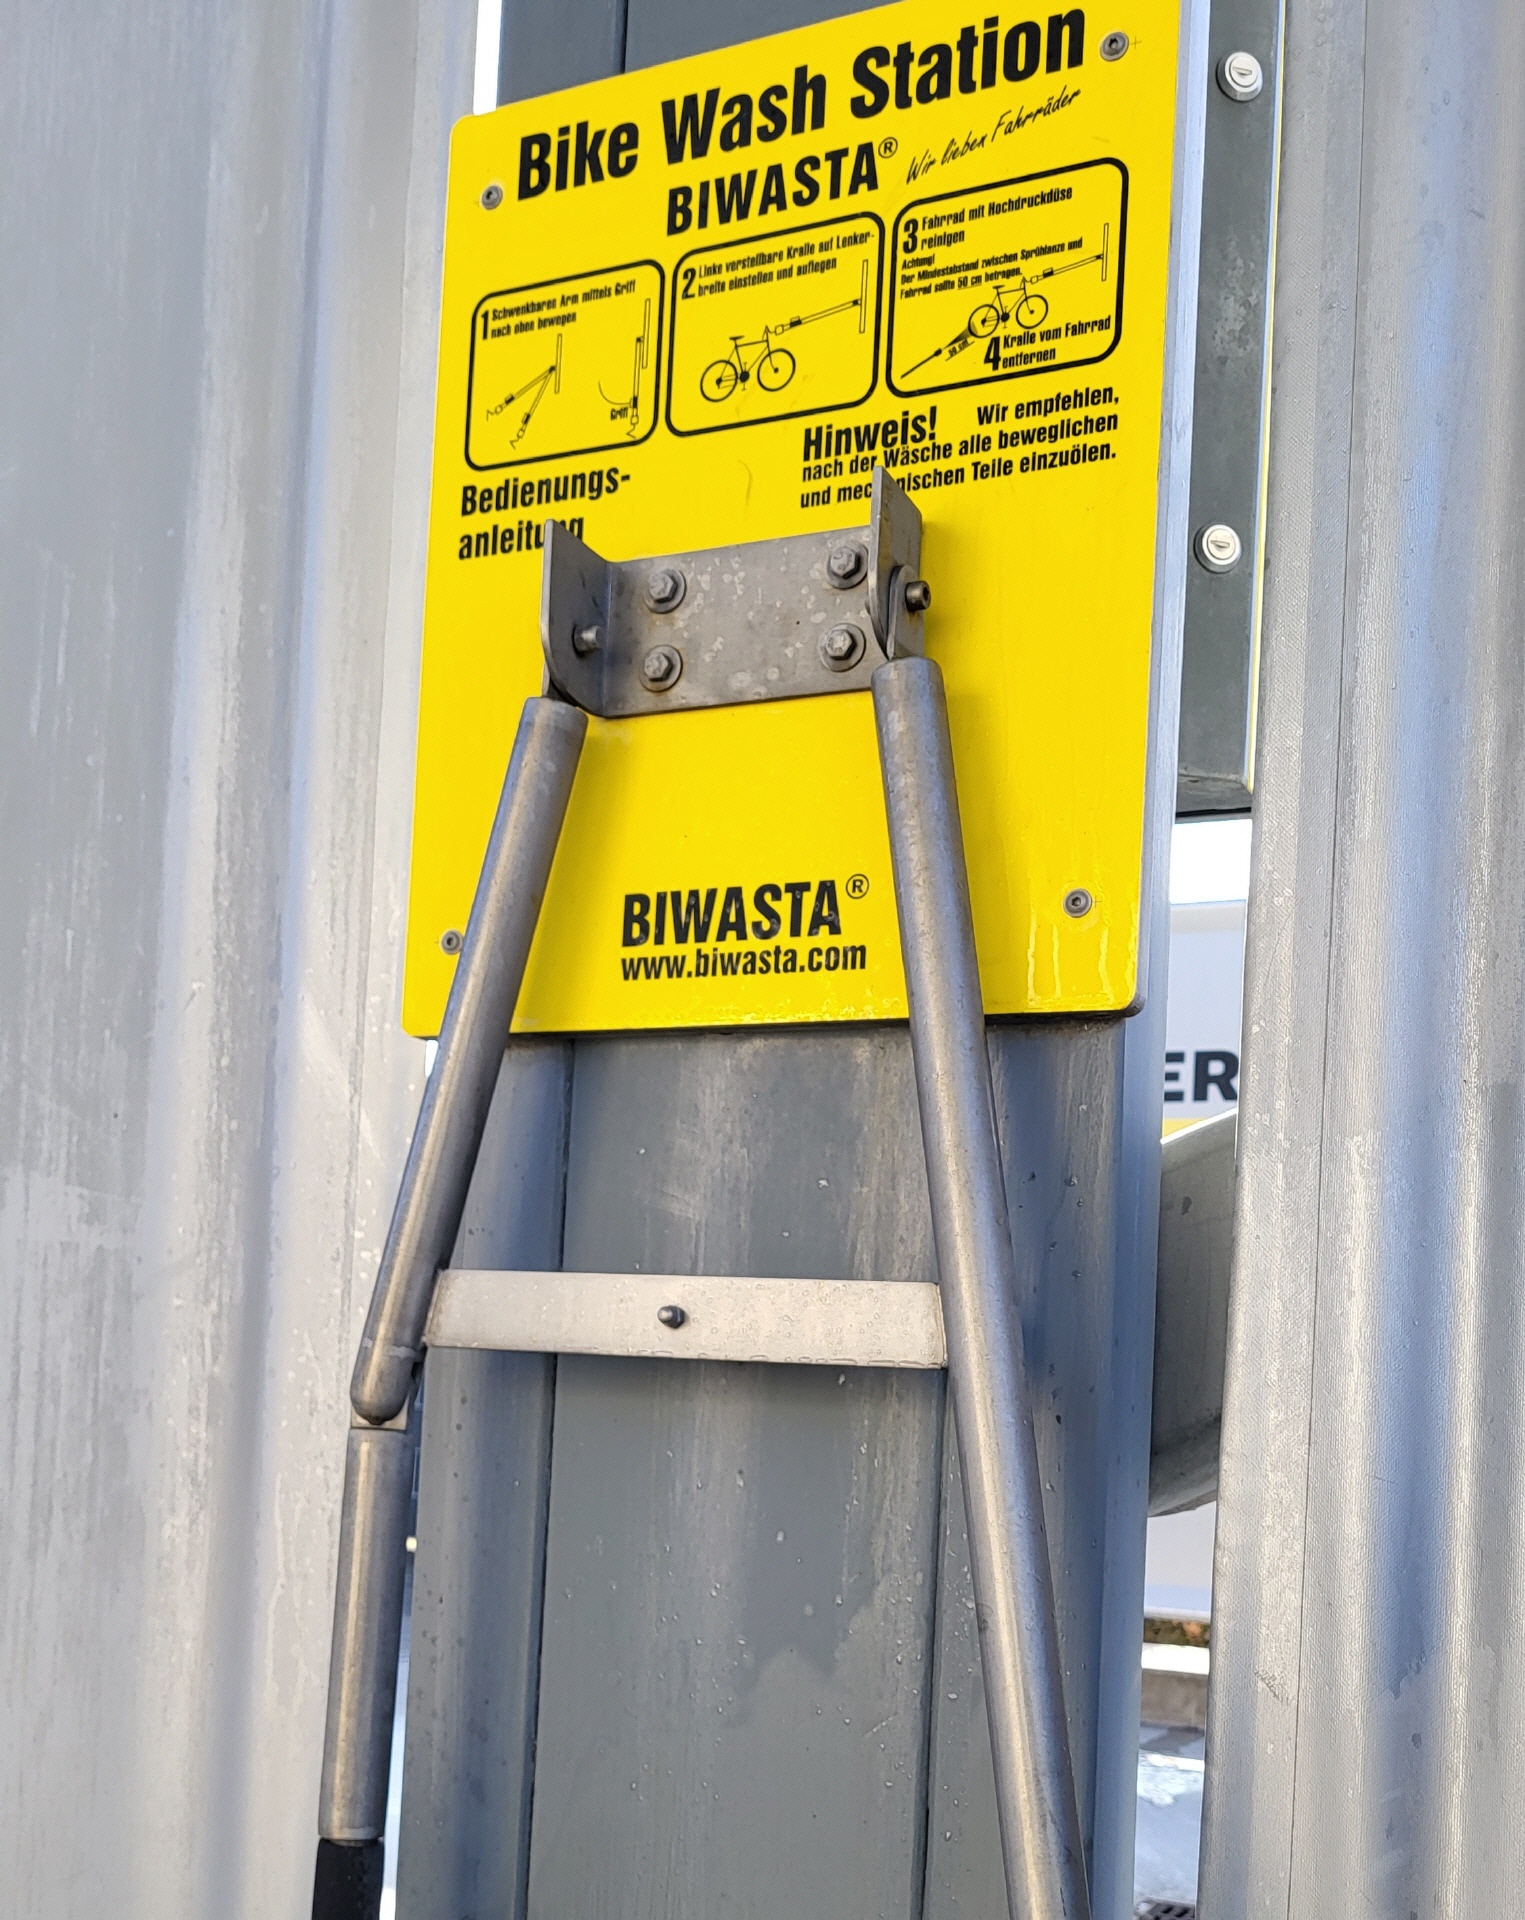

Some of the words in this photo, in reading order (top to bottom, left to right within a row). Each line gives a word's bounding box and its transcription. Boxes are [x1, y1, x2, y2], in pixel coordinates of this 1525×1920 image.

[516, 121, 639, 200] Bike
[661, 64, 826, 166] Wash
[849, 6, 1086, 119] Station
[906, 149, 937, 185] Wir
[941, 131, 988, 166] lieben
[991, 84, 1081, 143] Fahrräder
[903, 218, 918, 254] 3
[922, 209, 965, 231] Fahrrad
[969, 203, 985, 219] mit
[988, 187, 1073, 216] Hochdruckdüse
[921, 230, 965, 251] reinigen
[682, 267, 696, 300] 2
[699, 264, 722, 279] Linke
[726, 249, 784, 273] verstellbare
[787, 243, 815, 259] Kralle
[818, 238, 834, 253] auf
[837, 231, 875, 249] Lenker-
[698, 281, 726, 297] breite
[729, 270, 774, 290] einstellen
[777, 265, 793, 280] und
[797, 257, 837, 276] auflegen
[900, 283, 933, 300] Fahrrad
[934, 280, 956, 292] sollte
[958, 277, 968, 288] 50
[971, 276, 982, 286] cm
[985, 268, 1023, 283] betragen.
[901, 274, 915, 285] Der
[918, 259, 979, 281] Mindestabstand
[982, 252, 1018, 269] zwischen
[1021, 241, 1065, 261] Sprühlanze
[1068, 237, 1083, 251] und
[902, 254, 936, 270] Achtung!
[481, 310, 489, 340] 1
[492, 299, 556, 321] Schwenkbaren
[560, 294, 579, 307] Arm
[582, 286, 612, 303] mittels
[615, 279, 636, 296] Griff
[491, 325, 511, 338] nach
[515, 321, 535, 334] oben
[538, 312, 577, 329] bewegen
[984, 336, 1002, 371] 4
[1003, 330, 1036, 349] Kralle
[1040, 327, 1062, 341] vom
[1065, 315, 1111, 337] Fahrrad
[1002, 348, 1056, 369] entfernen
[610, 407, 628, 421] Griff
[977, 404, 1008, 426] Wir
[1015, 386, 1120, 419] empfehlen,
[802, 457, 843, 482] nach
[850, 450, 878, 474] der
[883, 441, 952, 468] Wäsche
[959, 435, 991, 457] alle
[998, 412, 1118, 449] beweglichen
[803, 405, 938, 463] Hinweis!
[462, 467, 631, 517] Bedienungs-
[800, 484, 831, 509] und
[837, 464, 964, 504] mecnischen
[971, 459, 1013, 481] Teile
[1020, 443, 1116, 473] einzuölen.
[621, 944, 867, 981] www.biwasta.com
